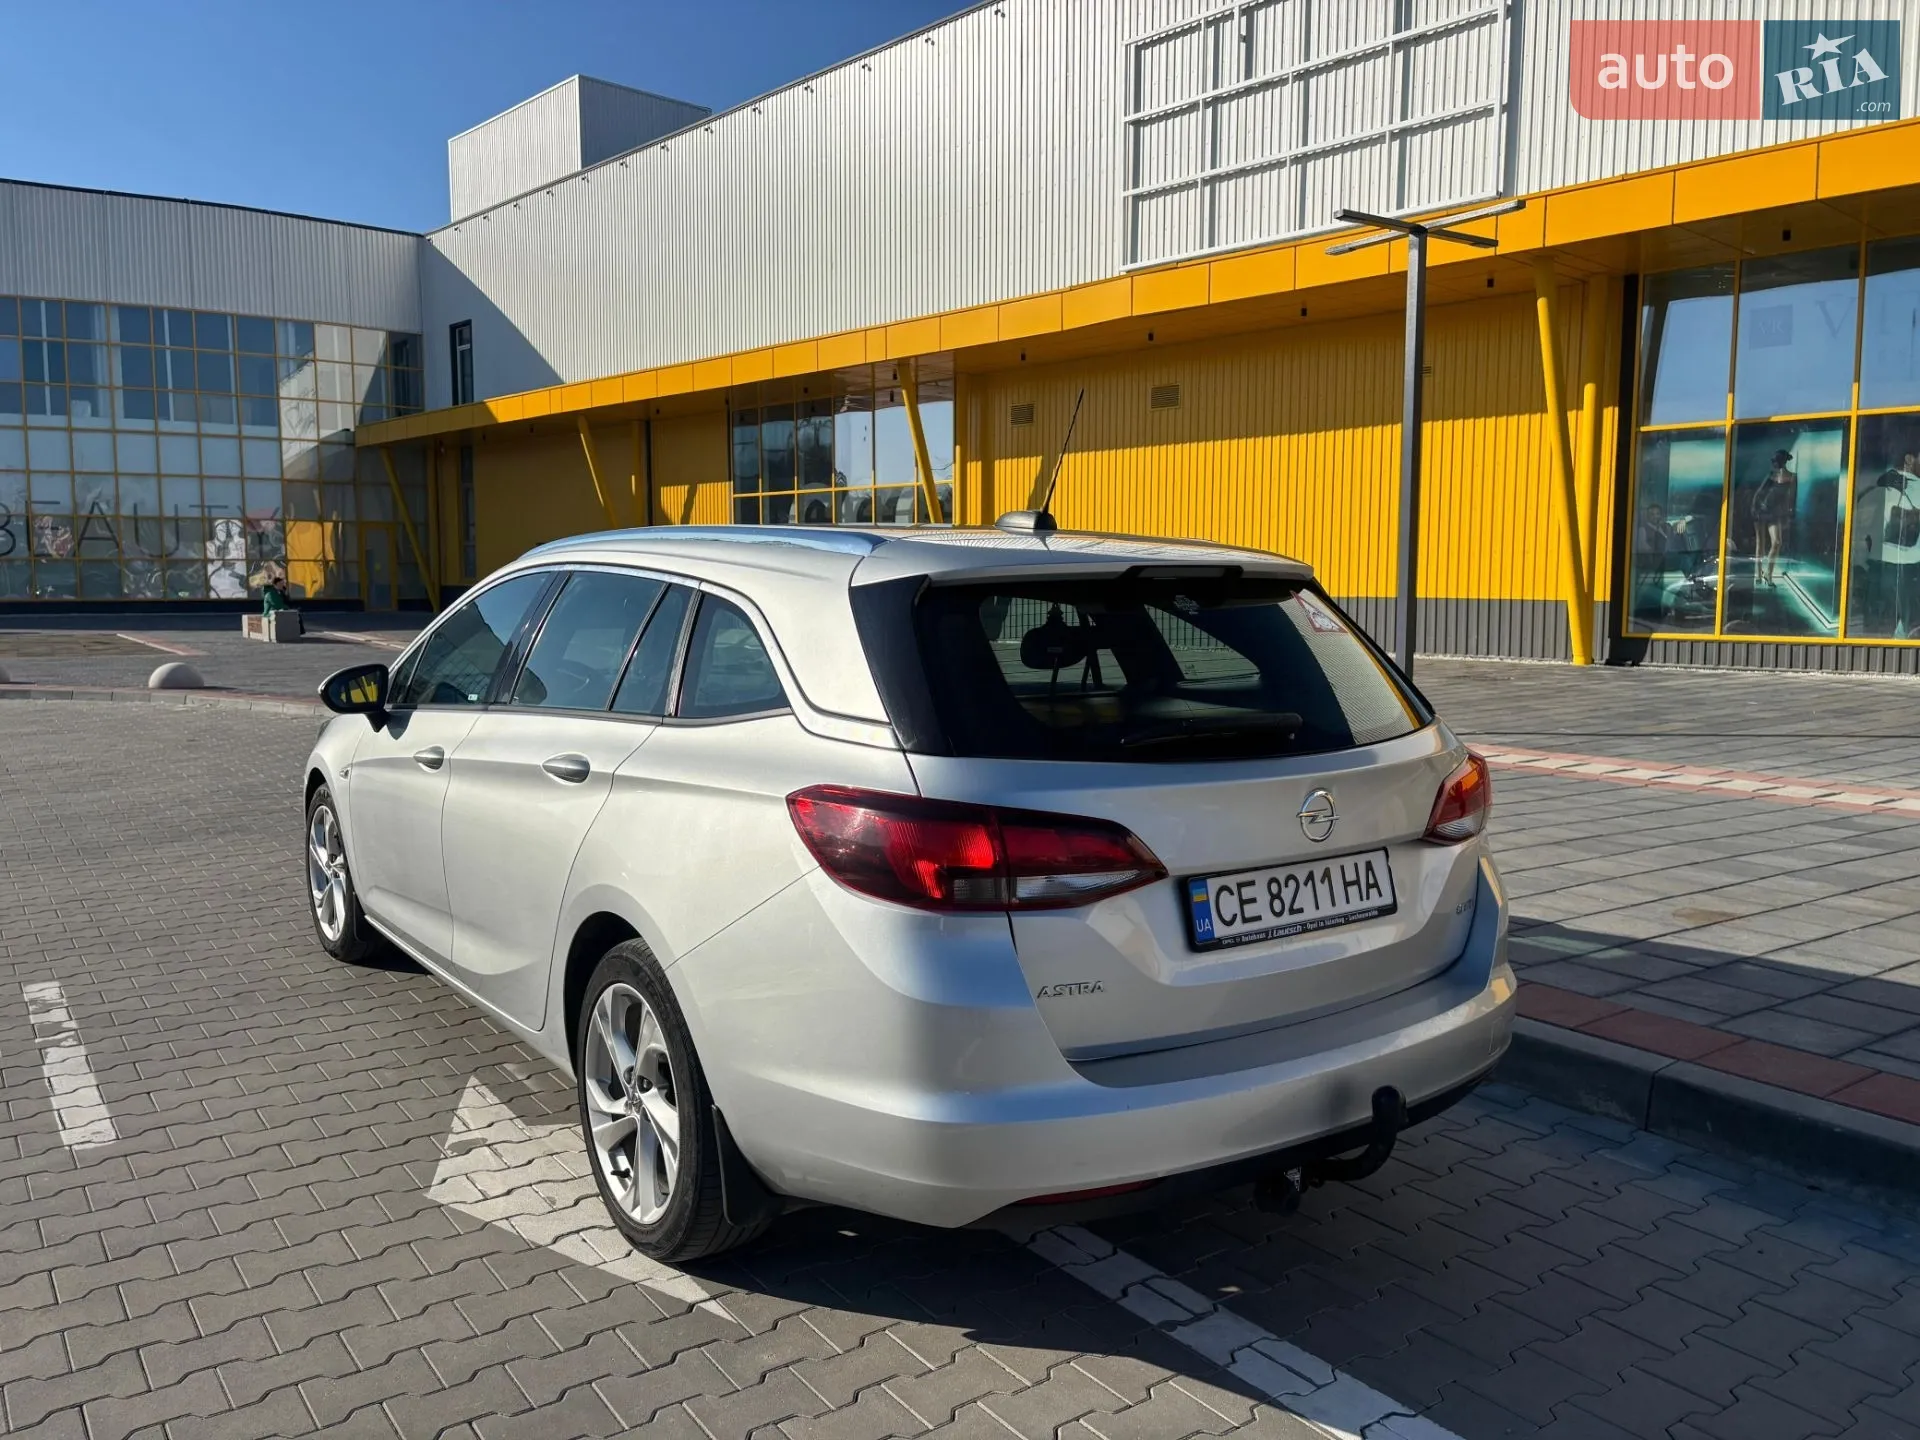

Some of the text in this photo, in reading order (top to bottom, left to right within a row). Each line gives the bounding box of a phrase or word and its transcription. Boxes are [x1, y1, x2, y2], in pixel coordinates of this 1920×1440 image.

[1215, 859, 1383, 927] CE 8211 HA
[1195, 918, 1212, 933] UA
[1036, 980, 1105, 999] ASTRA
